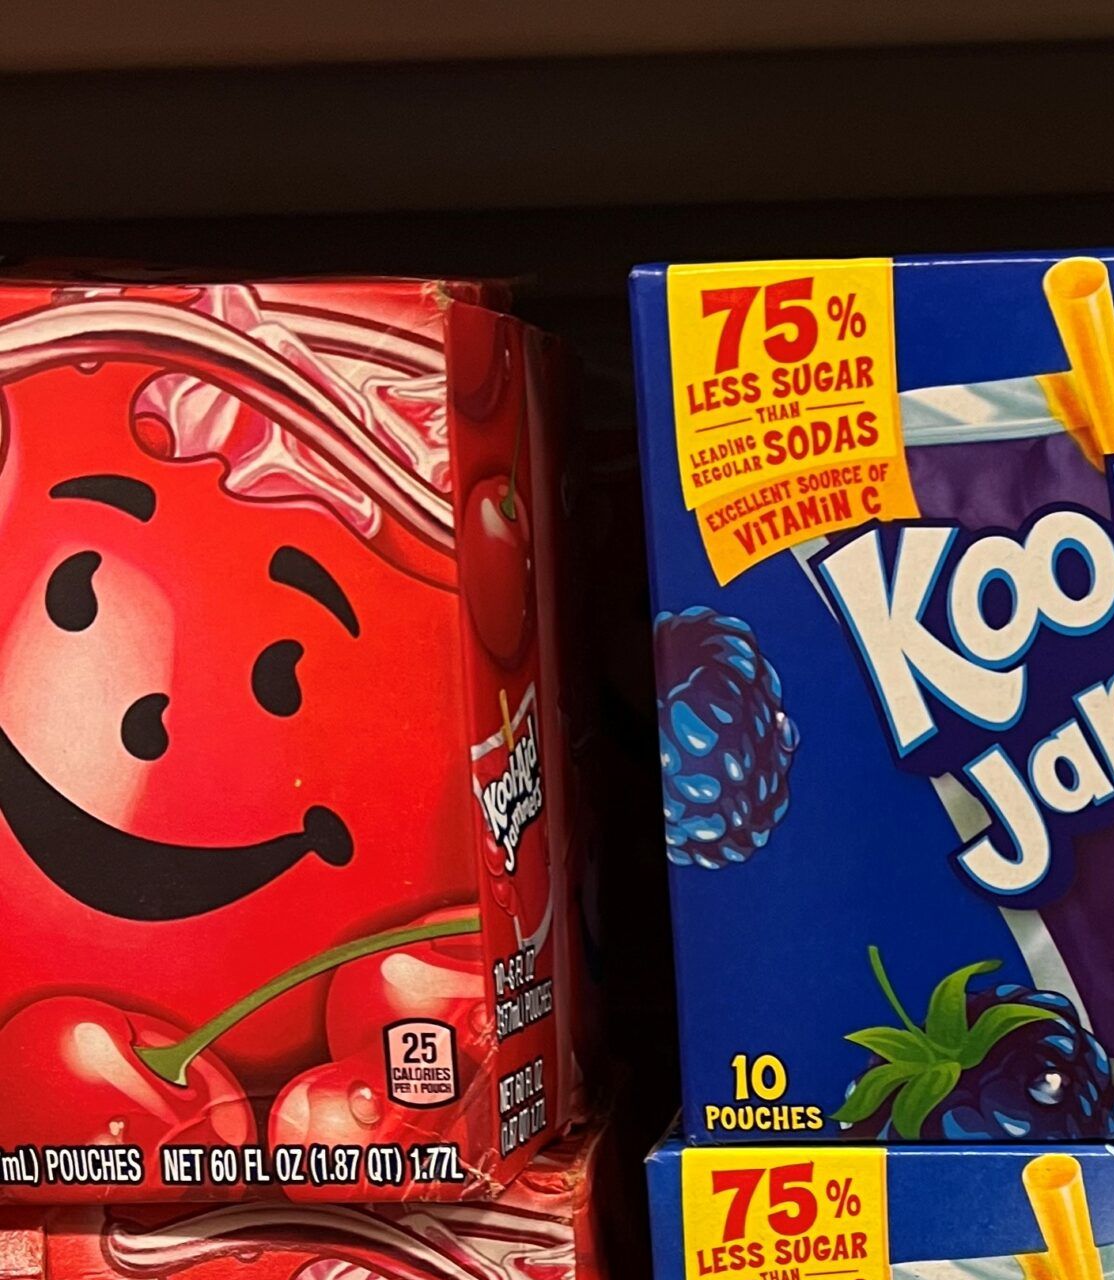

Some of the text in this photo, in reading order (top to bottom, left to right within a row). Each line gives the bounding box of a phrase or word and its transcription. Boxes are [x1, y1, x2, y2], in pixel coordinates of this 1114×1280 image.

[687, 356, 874, 414] LESS SUGAR
[756, 401, 799, 423] THAN
[690, 435, 756, 468] LEADING
[763, 412, 878, 466] SODAS
[693, 455, 762, 487] REGULAR
[706, 464, 889, 532] EXCELLENT SOURCE OF
[862, 487, 882, 514] C
[402, 1033, 437, 1063] 25
[392, 1068, 451, 1080] CALORIES
[731, 1054, 786, 1100] 10
[705, 1105, 823, 1130] POUCHES
[46, 1148, 142, 1181] POUCHES
[164, 1147, 463, 1183] NET 60 FL OZ (1.87 QT) 1.77L
[697, 1232, 867, 1276] LESS SUGAR
